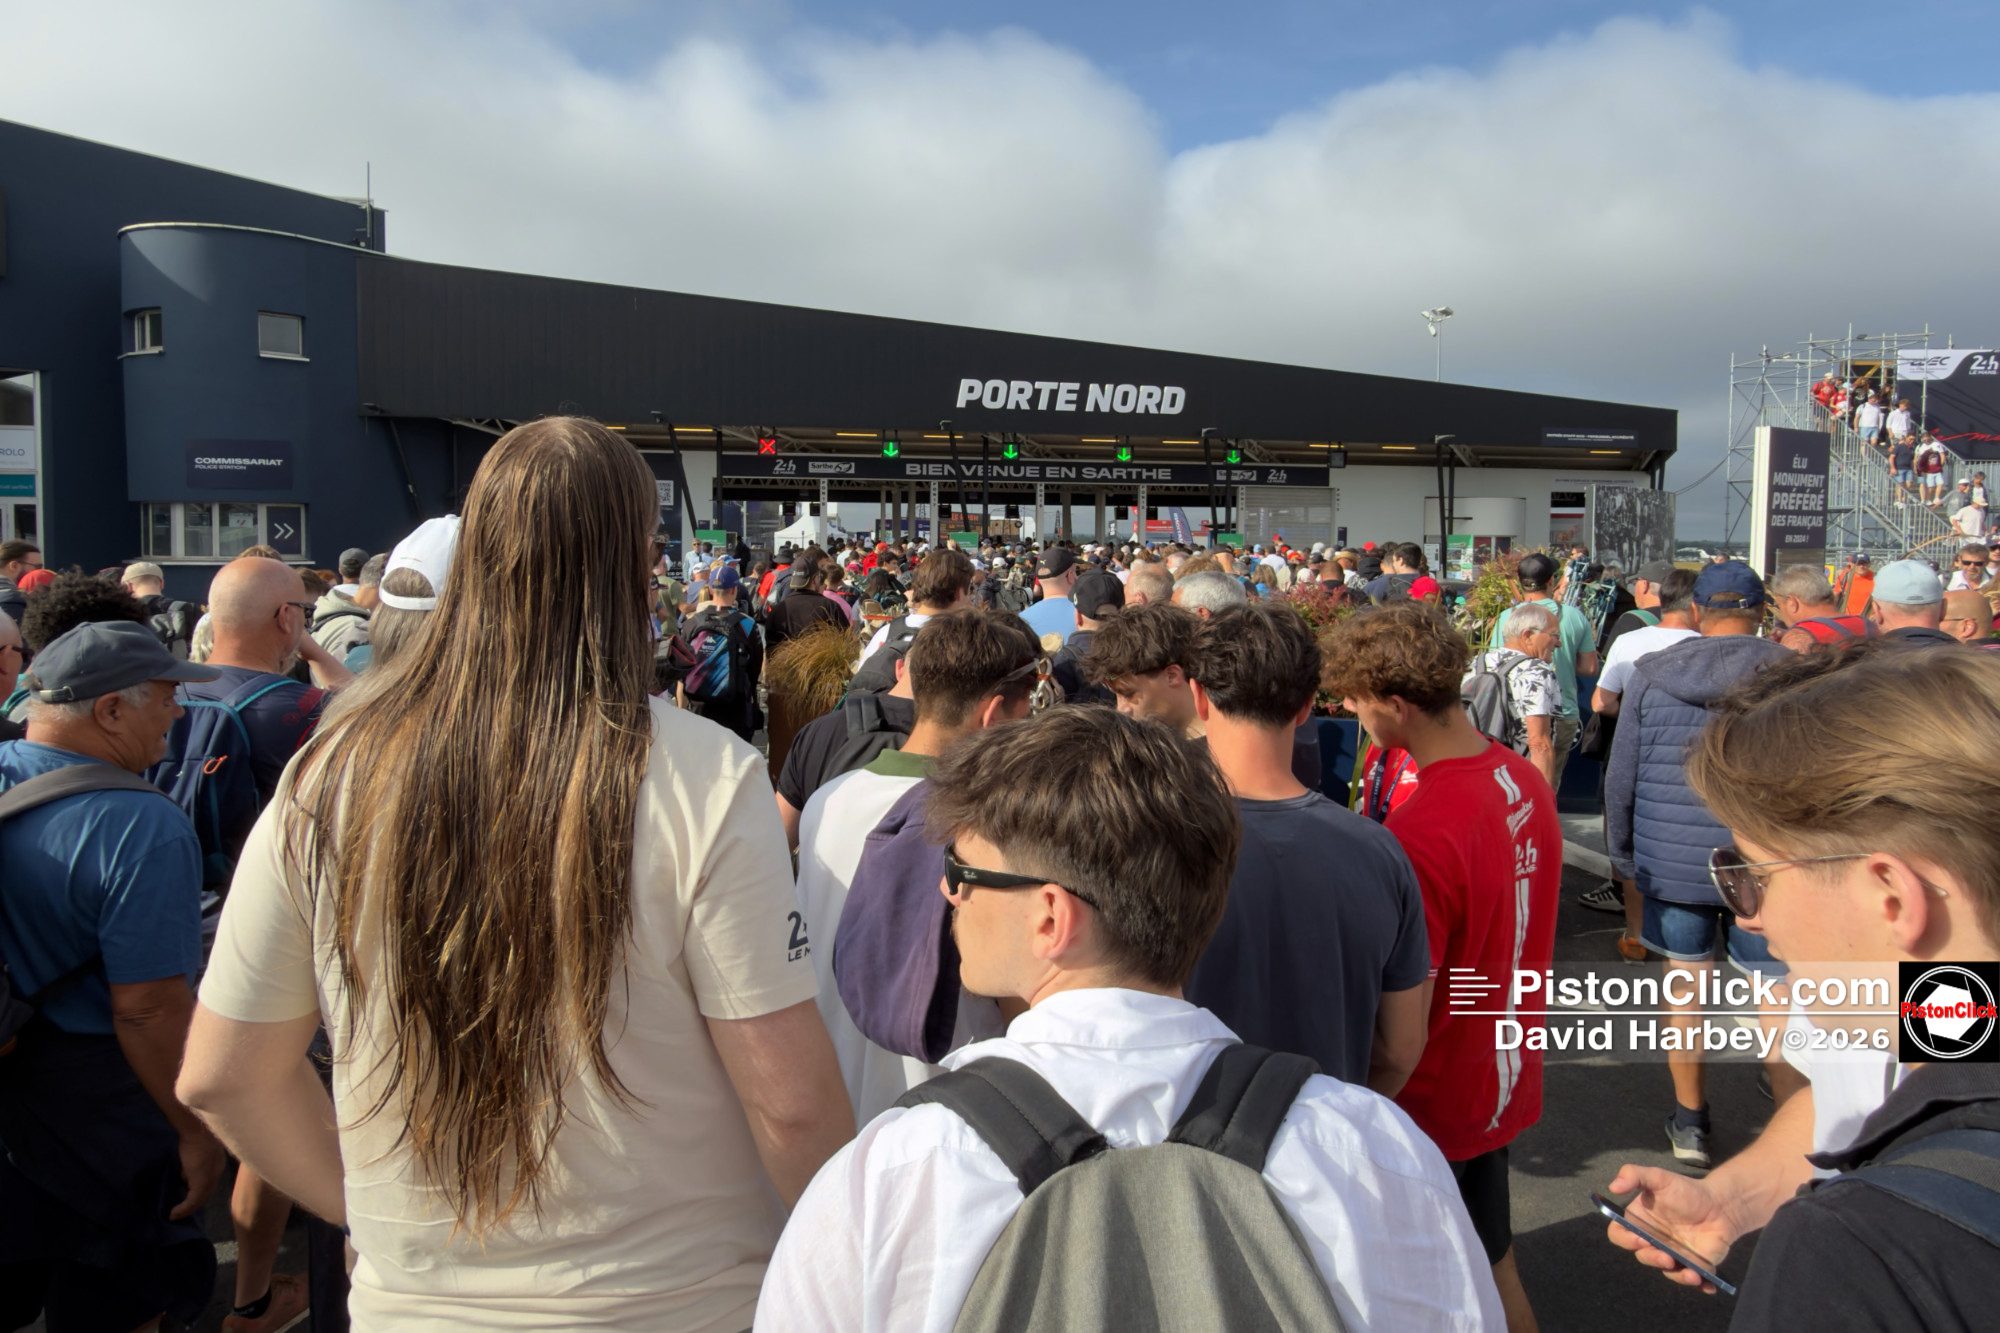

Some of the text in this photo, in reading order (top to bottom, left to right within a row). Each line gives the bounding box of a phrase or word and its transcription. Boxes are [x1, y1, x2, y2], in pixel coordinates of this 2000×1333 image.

[1970, 354, 2000, 370] 24h
[956, 378, 1186, 415] PORTE NORD
[194, 457, 283, 466] COMMISSARIAT
[774, 459, 797, 471] 24h
[1792, 454, 1808, 469] ÉLU
[905, 463, 1172, 480] BIENVENUE EN SARTHE
[1772, 472, 1825, 488] MONUMENT
[1772, 488, 1825, 511] PRÉFÉRÉ
[1771, 514, 1823, 530] DES FRANÇAIS
[1785, 534, 1793, 543] EN
[788, 949, 803, 962] LE
